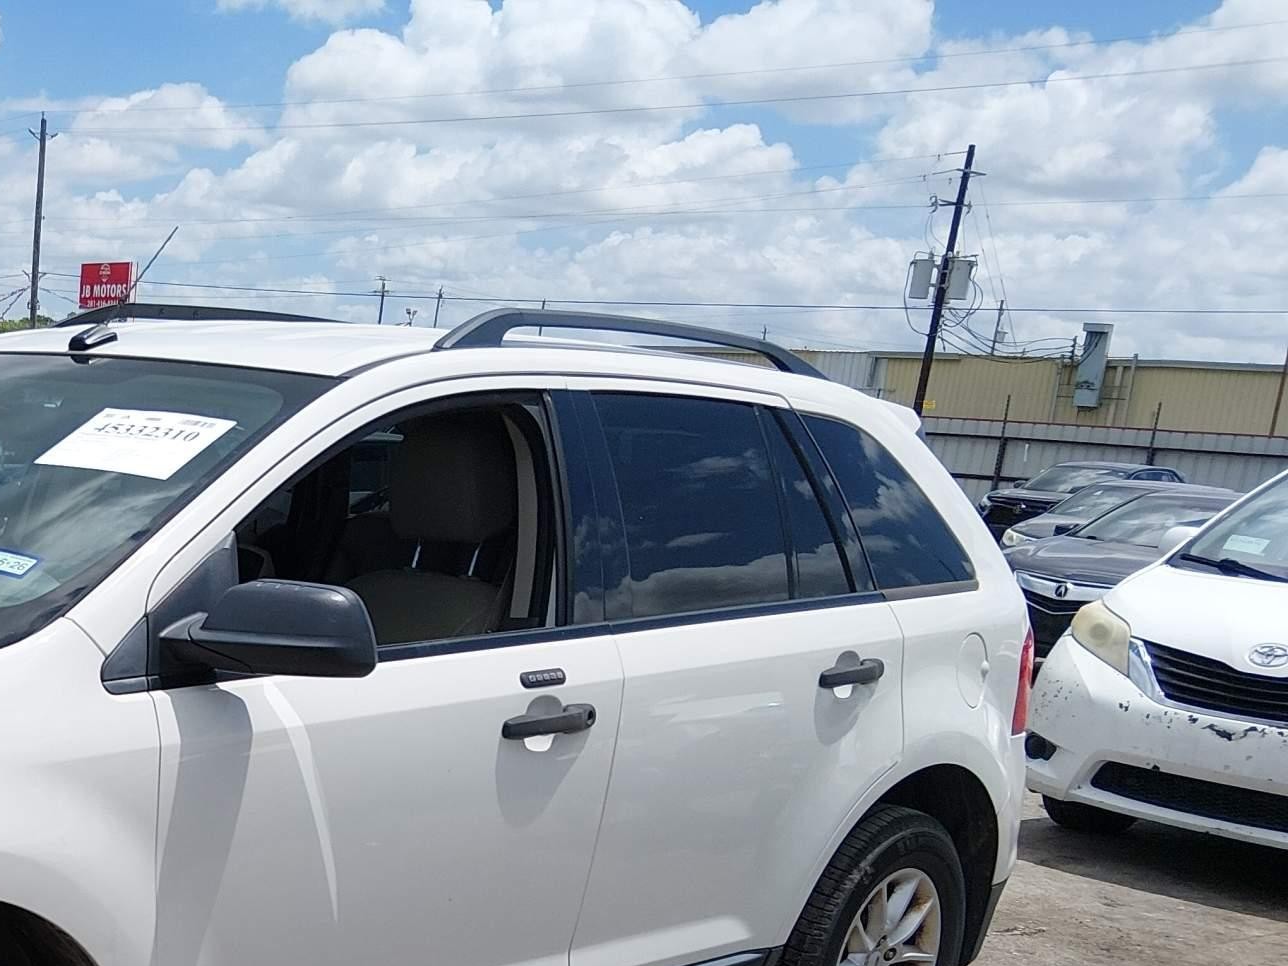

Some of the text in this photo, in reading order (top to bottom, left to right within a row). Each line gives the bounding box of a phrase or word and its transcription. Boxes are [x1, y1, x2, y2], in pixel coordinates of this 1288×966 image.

[81, 284, 126, 298] JB MOTORS
[94, 423, 200, 441] 45332310
